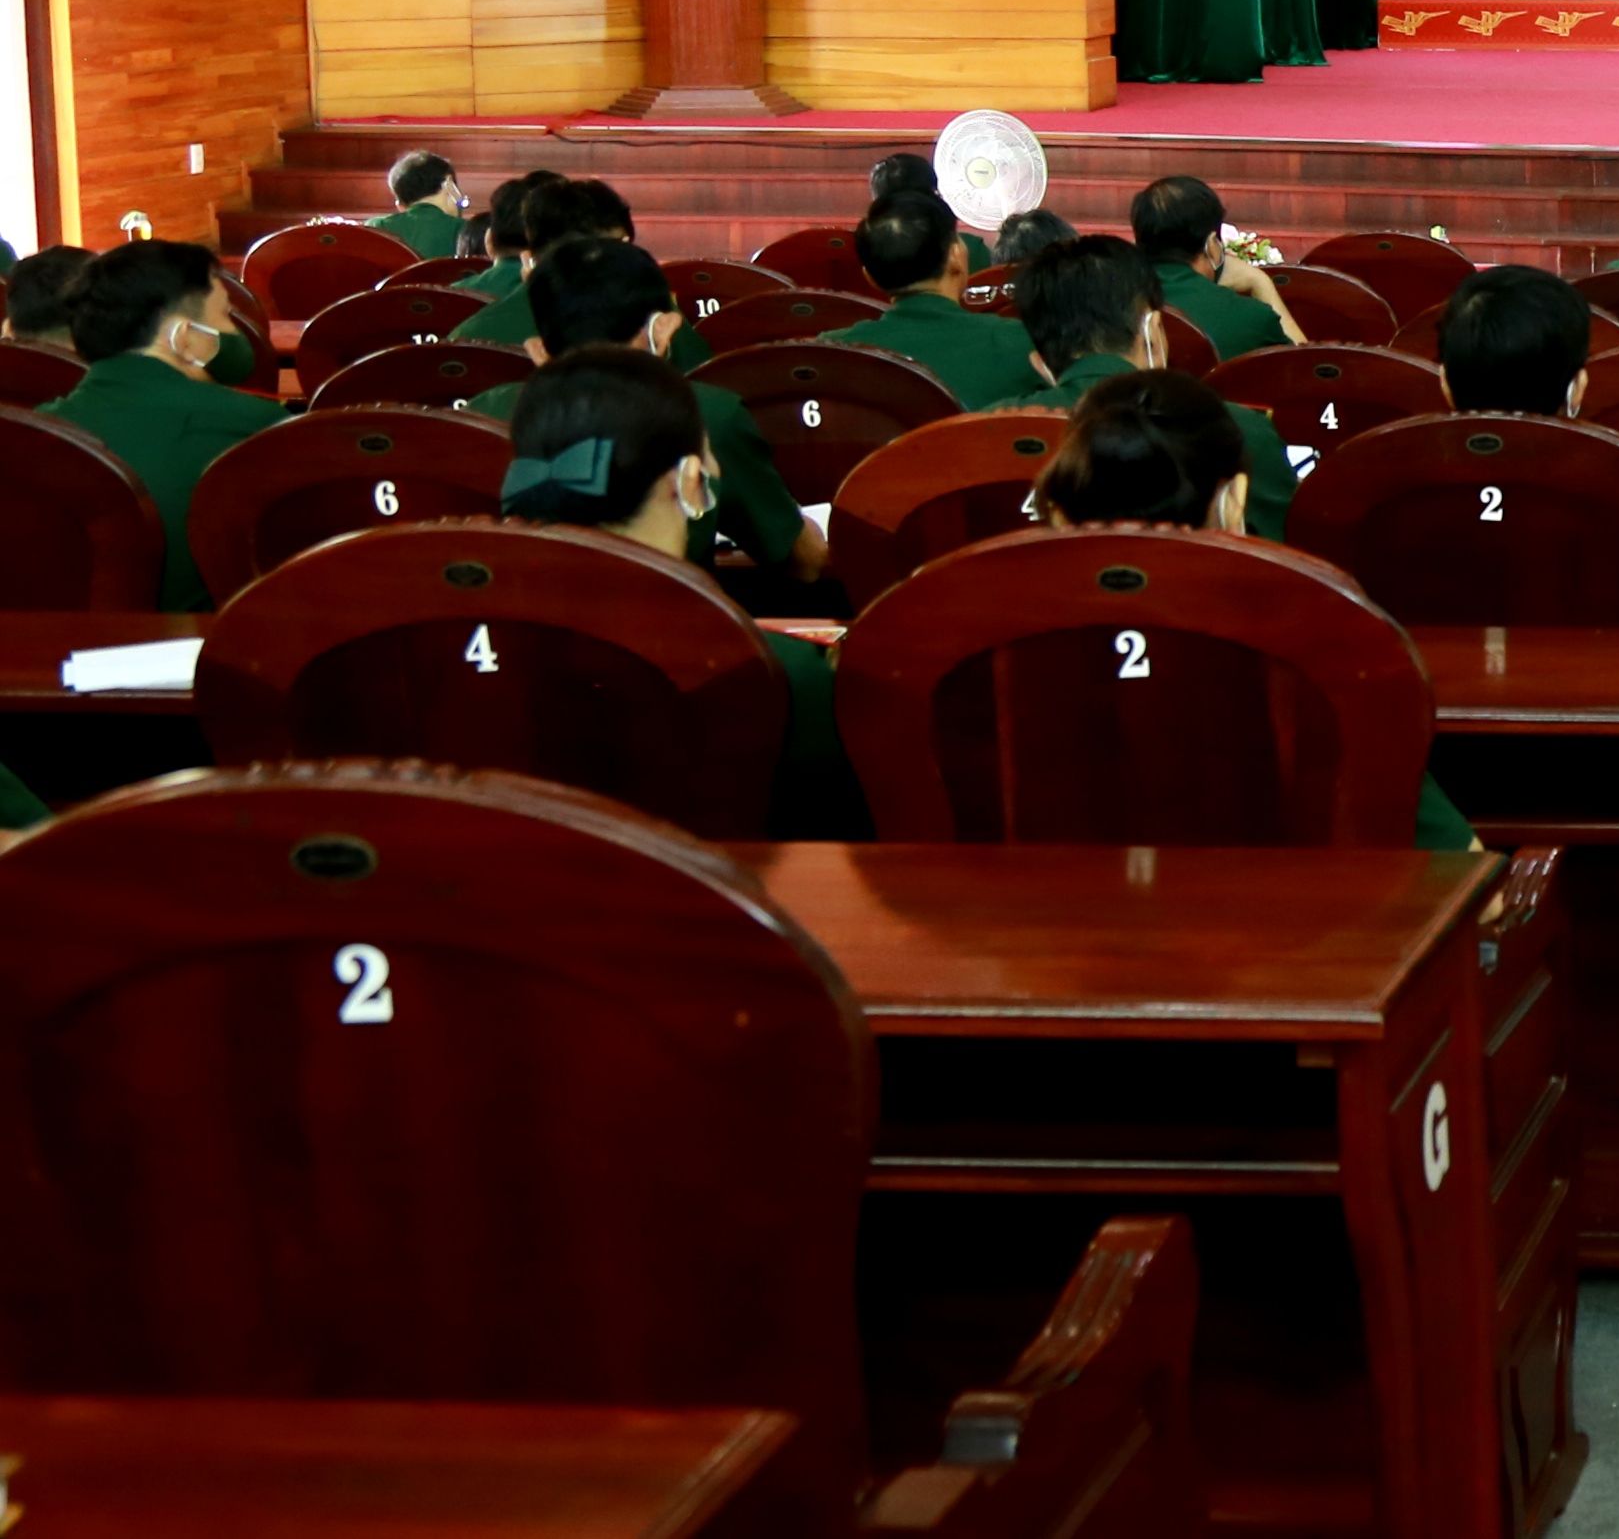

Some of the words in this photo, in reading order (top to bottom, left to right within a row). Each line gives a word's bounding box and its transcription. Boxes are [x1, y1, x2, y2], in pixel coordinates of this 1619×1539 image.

[696, 298, 720, 317] 10
[802, 400, 821, 427] 6
[1320, 403, 1338, 429] 4
[375, 481, 399, 515] 6
[1480, 487, 1503, 521] 2
[465, 625, 498, 672] 4
[1115, 630, 1150, 678] 2
[335, 944, 393, 1023] 2
[1423, 1083, 1449, 1190] G
